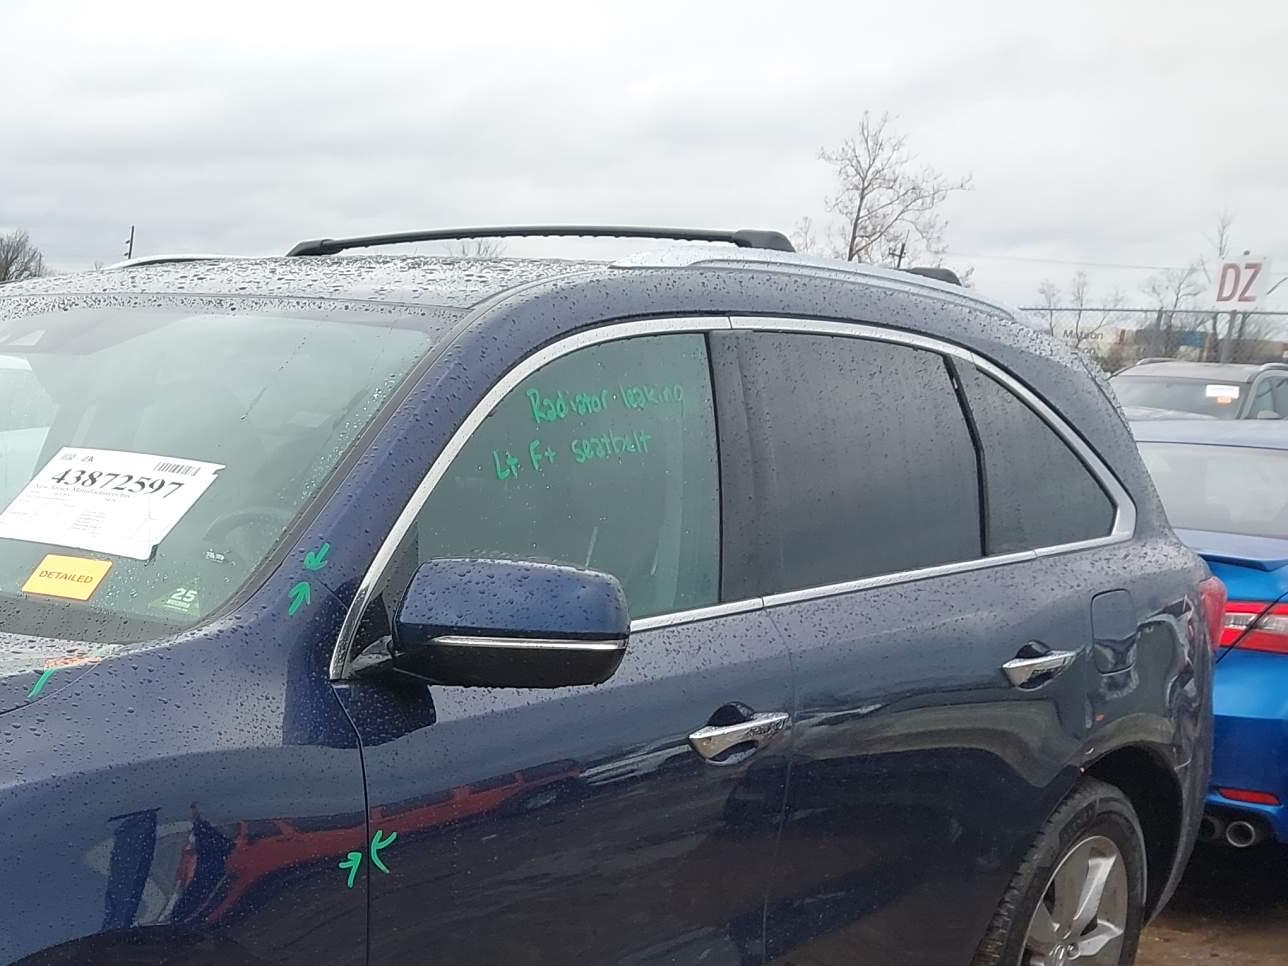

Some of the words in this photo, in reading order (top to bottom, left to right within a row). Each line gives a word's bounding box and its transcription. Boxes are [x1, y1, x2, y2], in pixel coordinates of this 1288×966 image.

[1215, 262, 1263, 303] DZ
[51, 467, 185, 499] 43872597
[38, 570, 94, 584] DETAILED
[170, 587, 198, 602] 25
